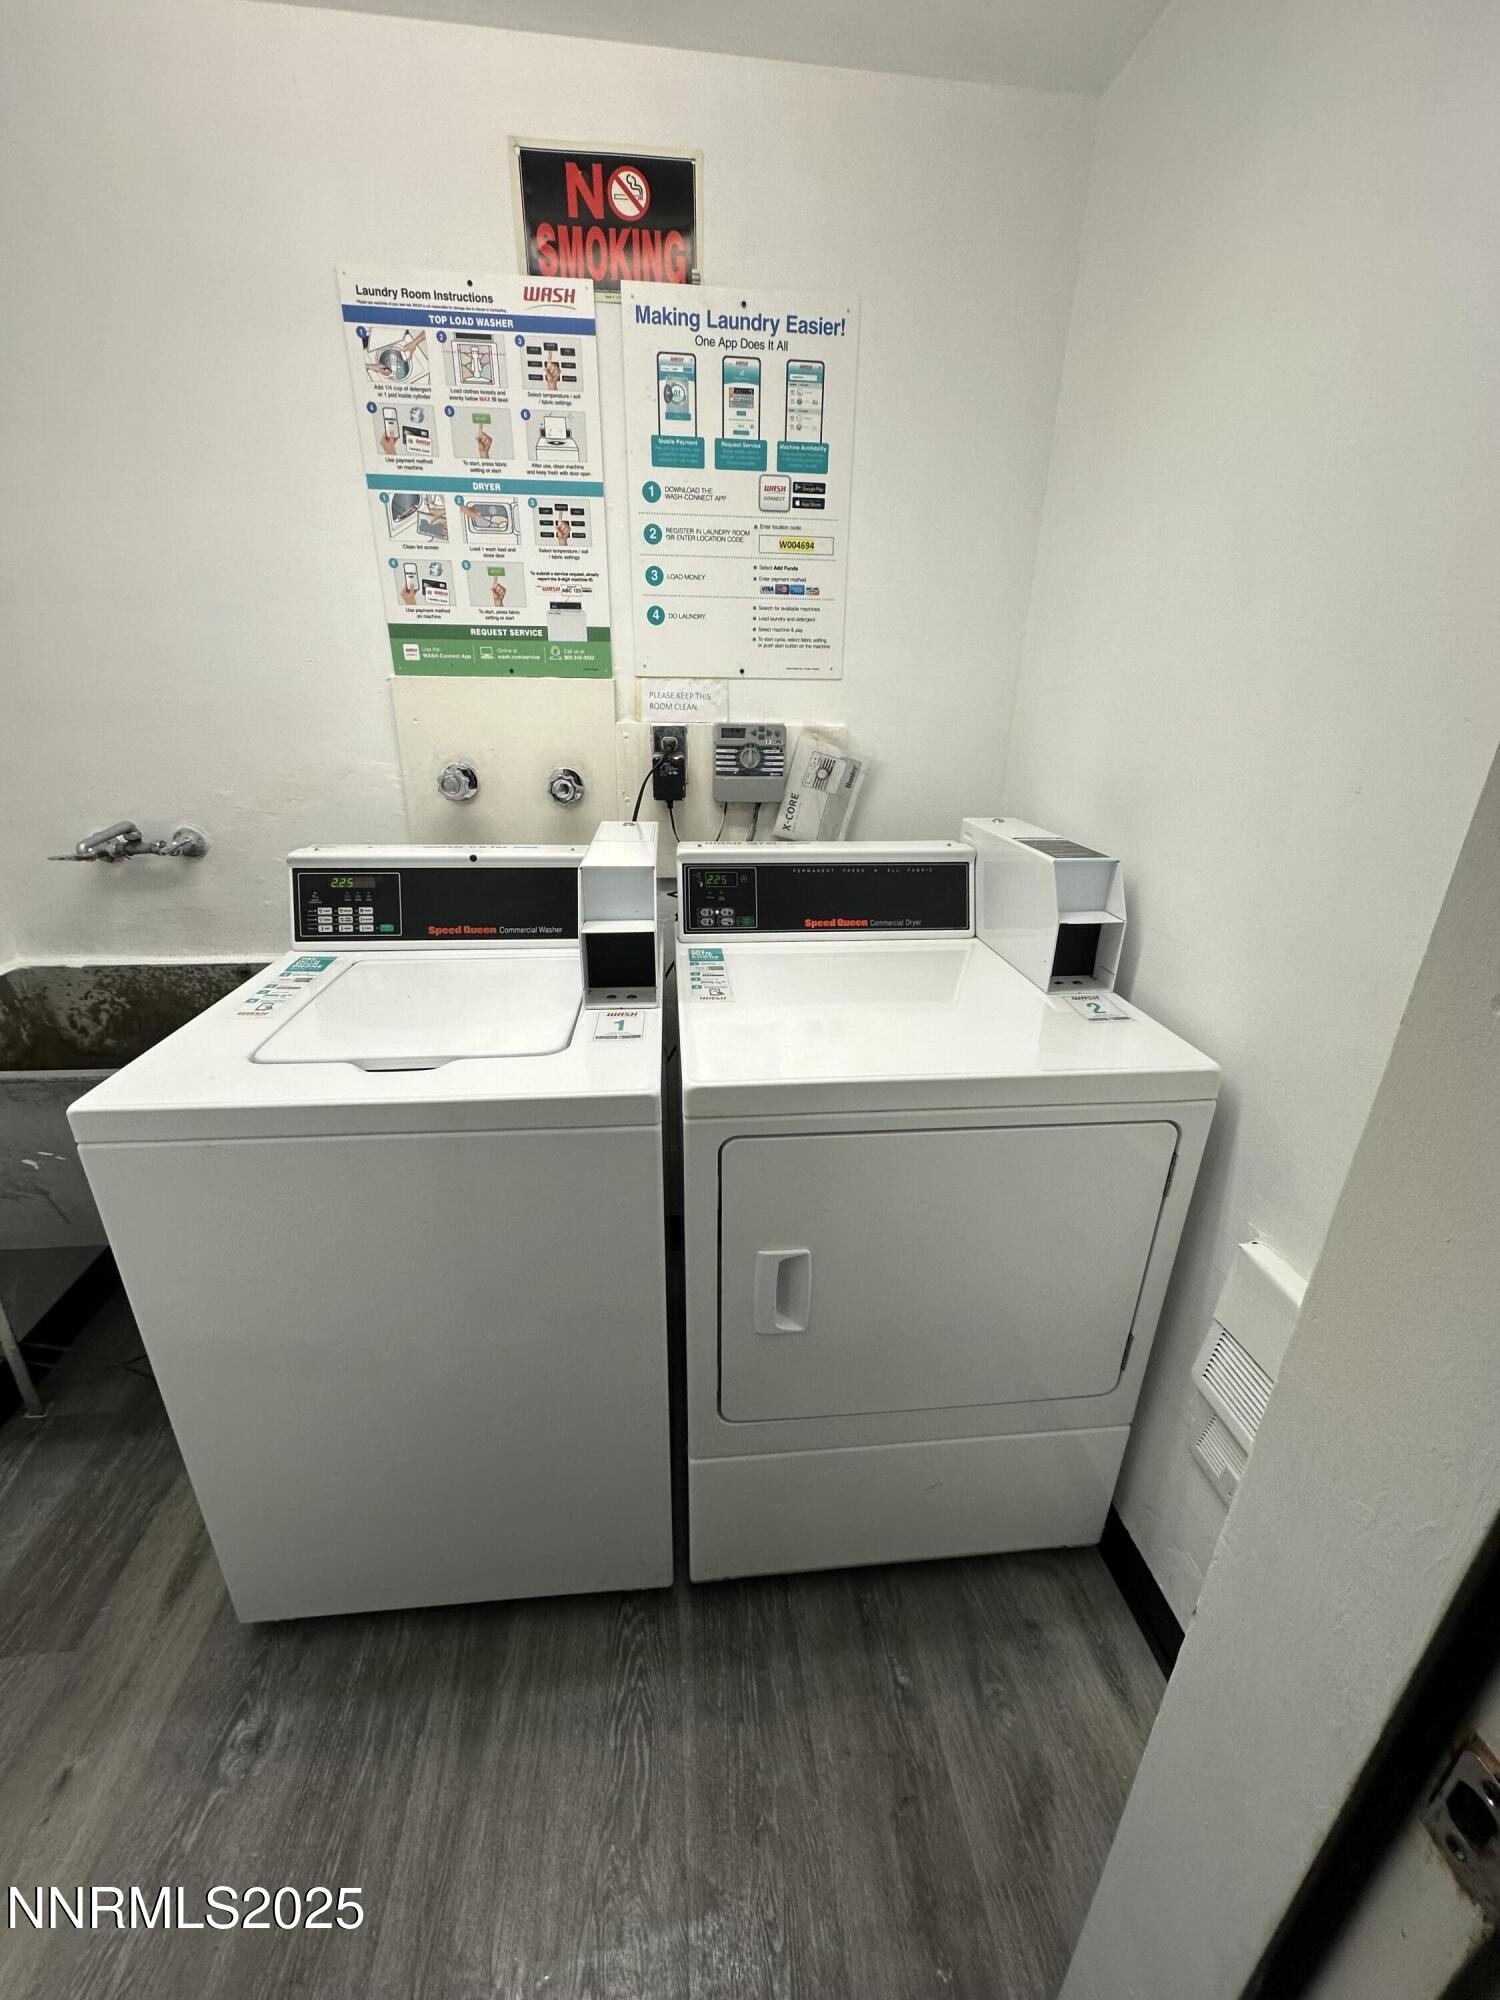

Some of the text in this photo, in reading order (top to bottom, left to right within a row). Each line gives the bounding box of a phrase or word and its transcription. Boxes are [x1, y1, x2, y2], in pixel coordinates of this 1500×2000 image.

[536, 222, 687, 284] SMOKING
[355, 284, 493, 304] Laundry Room Instructions
[523, 286, 575, 303] WASH
[428, 314, 514, 329] TOP LOAD WASHER
[635, 304, 846, 337] Making Laundry Easier!
[695, 335, 788, 352] One App Does It All
[676, 439, 698, 448] Payment
[721, 441, 742, 449] Request
[779, 443, 800, 451] Machine
[472, 482, 501, 492] DRYER
[664, 486, 700, 494] DOWNLOAD
[764, 484, 787, 493] WASH
[664, 493, 713, 502] WASH-CONNECT
[703, 528, 730, 536] LAUNDRY
[732, 529, 751, 537] ROOM
[779, 540, 815, 550] W004694
[668, 612, 706, 620] DO LAUNDRY
[470, 628, 544, 638] REQUEST SERVICE
[649, 691, 712, 700] PLEASE KEEP THIS
[649, 702, 673, 710] ROOM
[782, 793, 800, 832] X-CORE
[804, 918, 922, 929] Speed Queen Commercial Dryer
[428, 925, 563, 936] Speed Queen Commercial Washer
[1086, 1002, 1108, 1014] 2
[613, 1019, 625, 1031] 1
